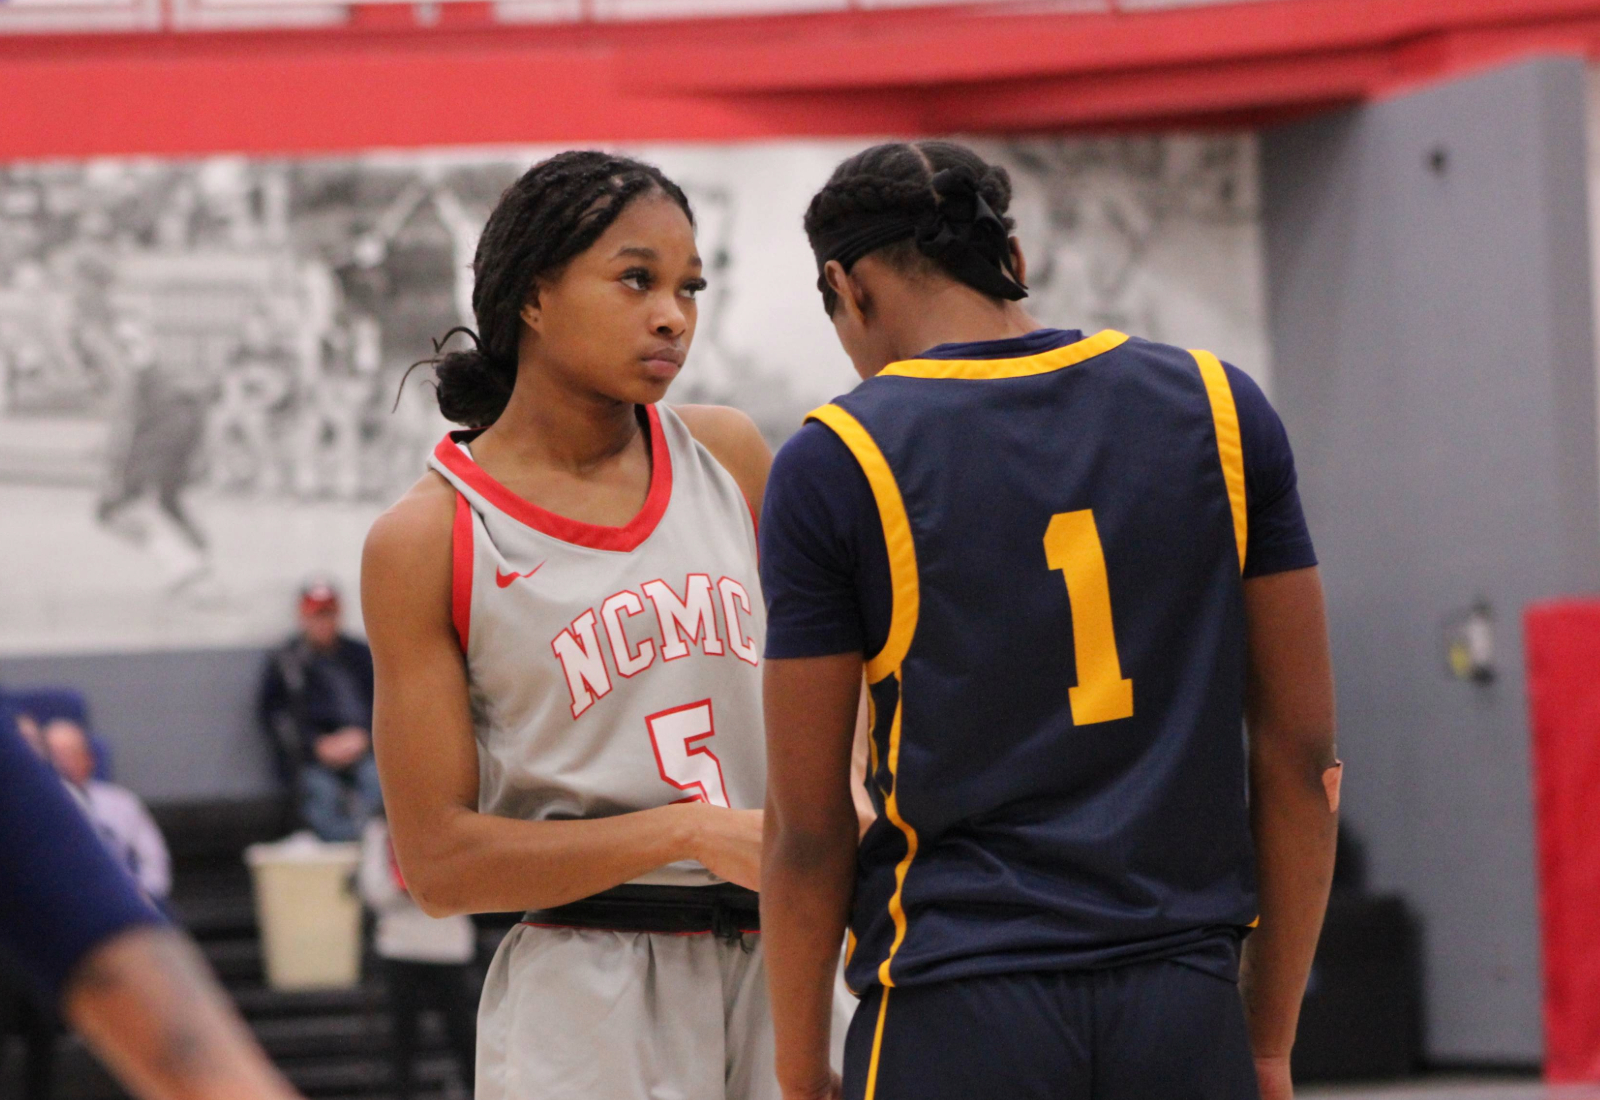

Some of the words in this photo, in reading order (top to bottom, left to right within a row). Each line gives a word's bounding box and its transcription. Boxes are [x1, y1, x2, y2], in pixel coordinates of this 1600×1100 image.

[551, 573, 758, 720] NCMC
[1043, 508, 1134, 726] 1
[644, 698, 731, 808] 5
